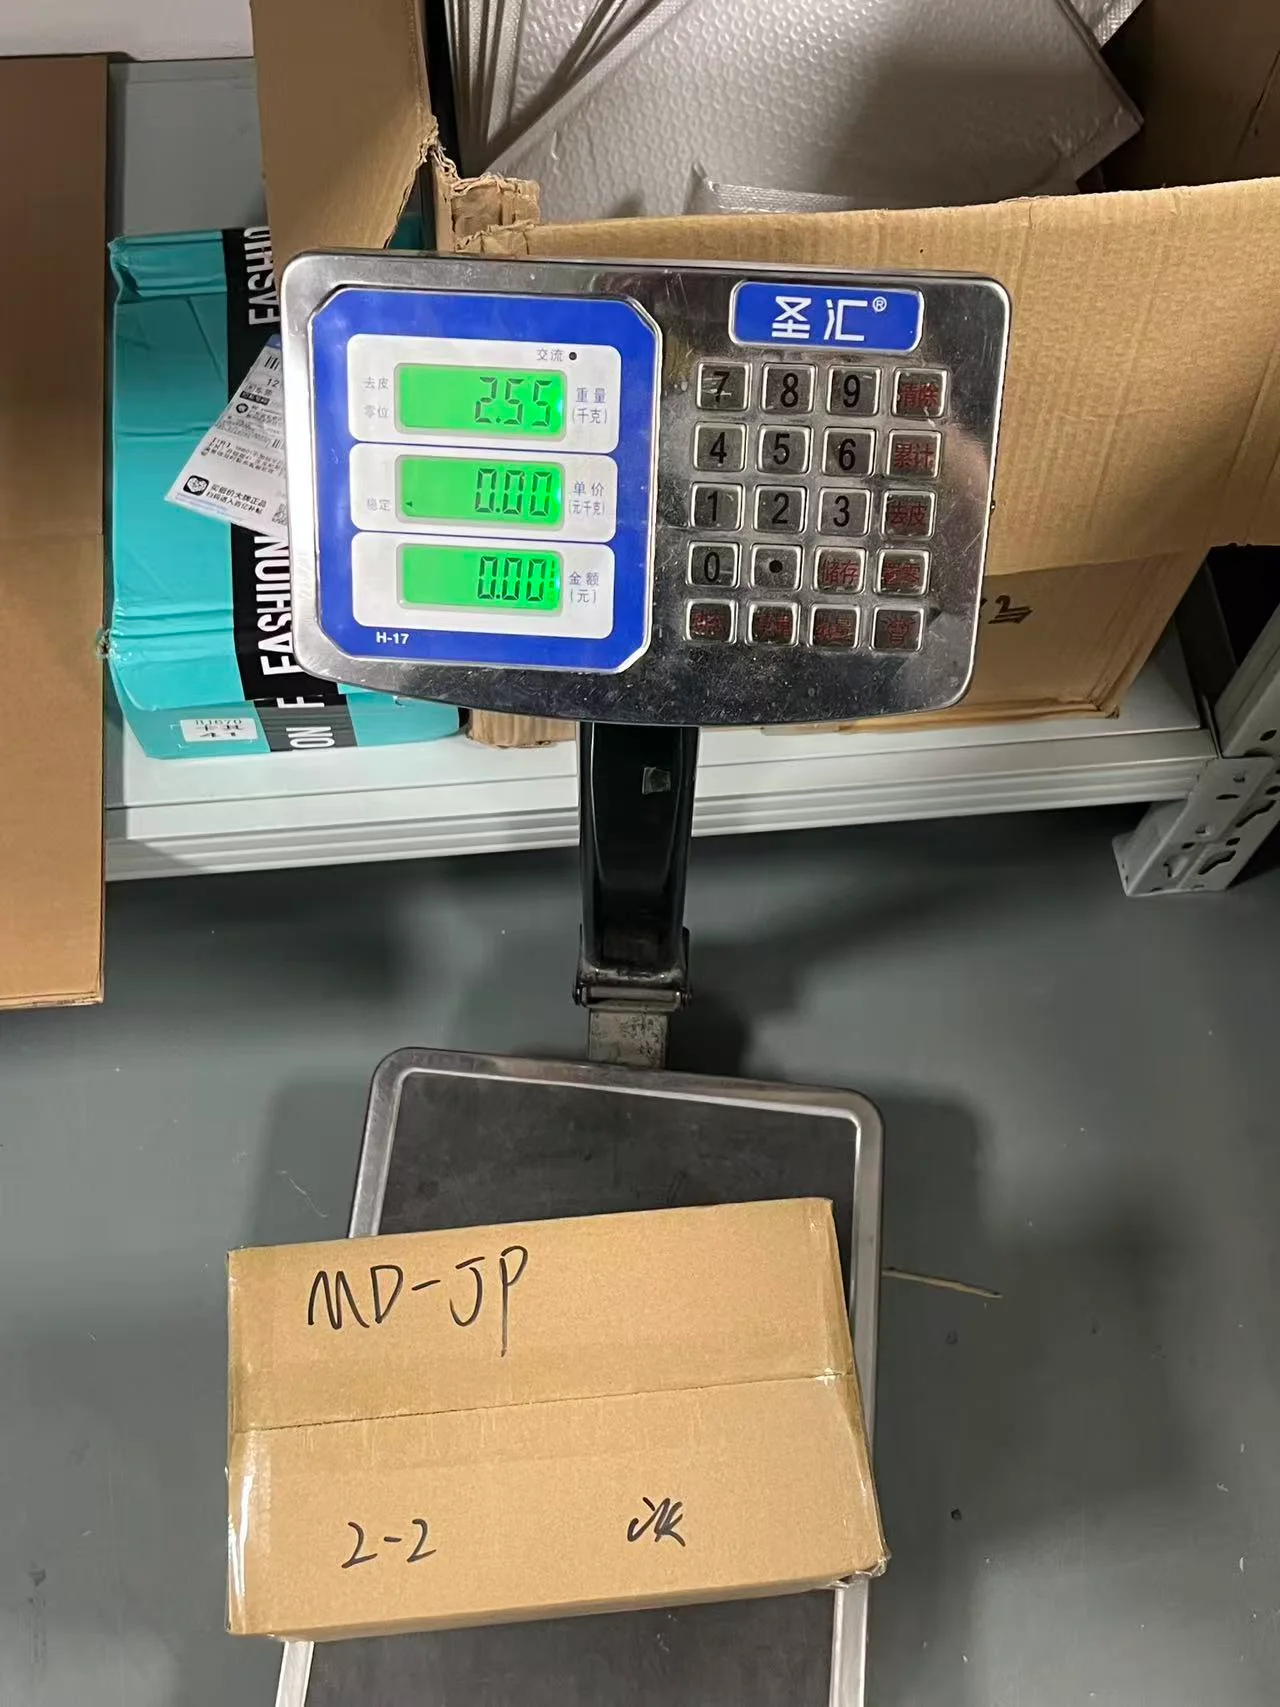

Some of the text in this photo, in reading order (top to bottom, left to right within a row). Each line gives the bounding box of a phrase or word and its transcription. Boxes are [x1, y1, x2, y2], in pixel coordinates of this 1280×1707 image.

[536, 348, 564, 363] 交流
[363, 376, 389, 391] 去皮
[575, 388, 607, 404] 重量
[713, 371, 861, 408] 7 8 9
[363, 404, 389, 419] 零位
[474, 376, 552, 428] 2.55
[571, 408, 608, 425] (千克)
[709, 431, 856, 471] 4 5 6
[895, 442, 934, 469] 累计
[474, 468, 551, 517] 0.00
[573, 481, 605, 496] 单价
[706, 493, 850, 528] 1 2 3
[476, 555, 547, 602] 0.00
[568, 571, 600, 587] 金额
[703, 551, 720, 584] 0
[253, 535, 304, 676] FASHION
[569, 588, 597, 604] (元)
[375, 631, 409, 645] H-17
[307, 1245, 529, 1358] MD-JP
[341, 1518, 437, 1569] 2-2
